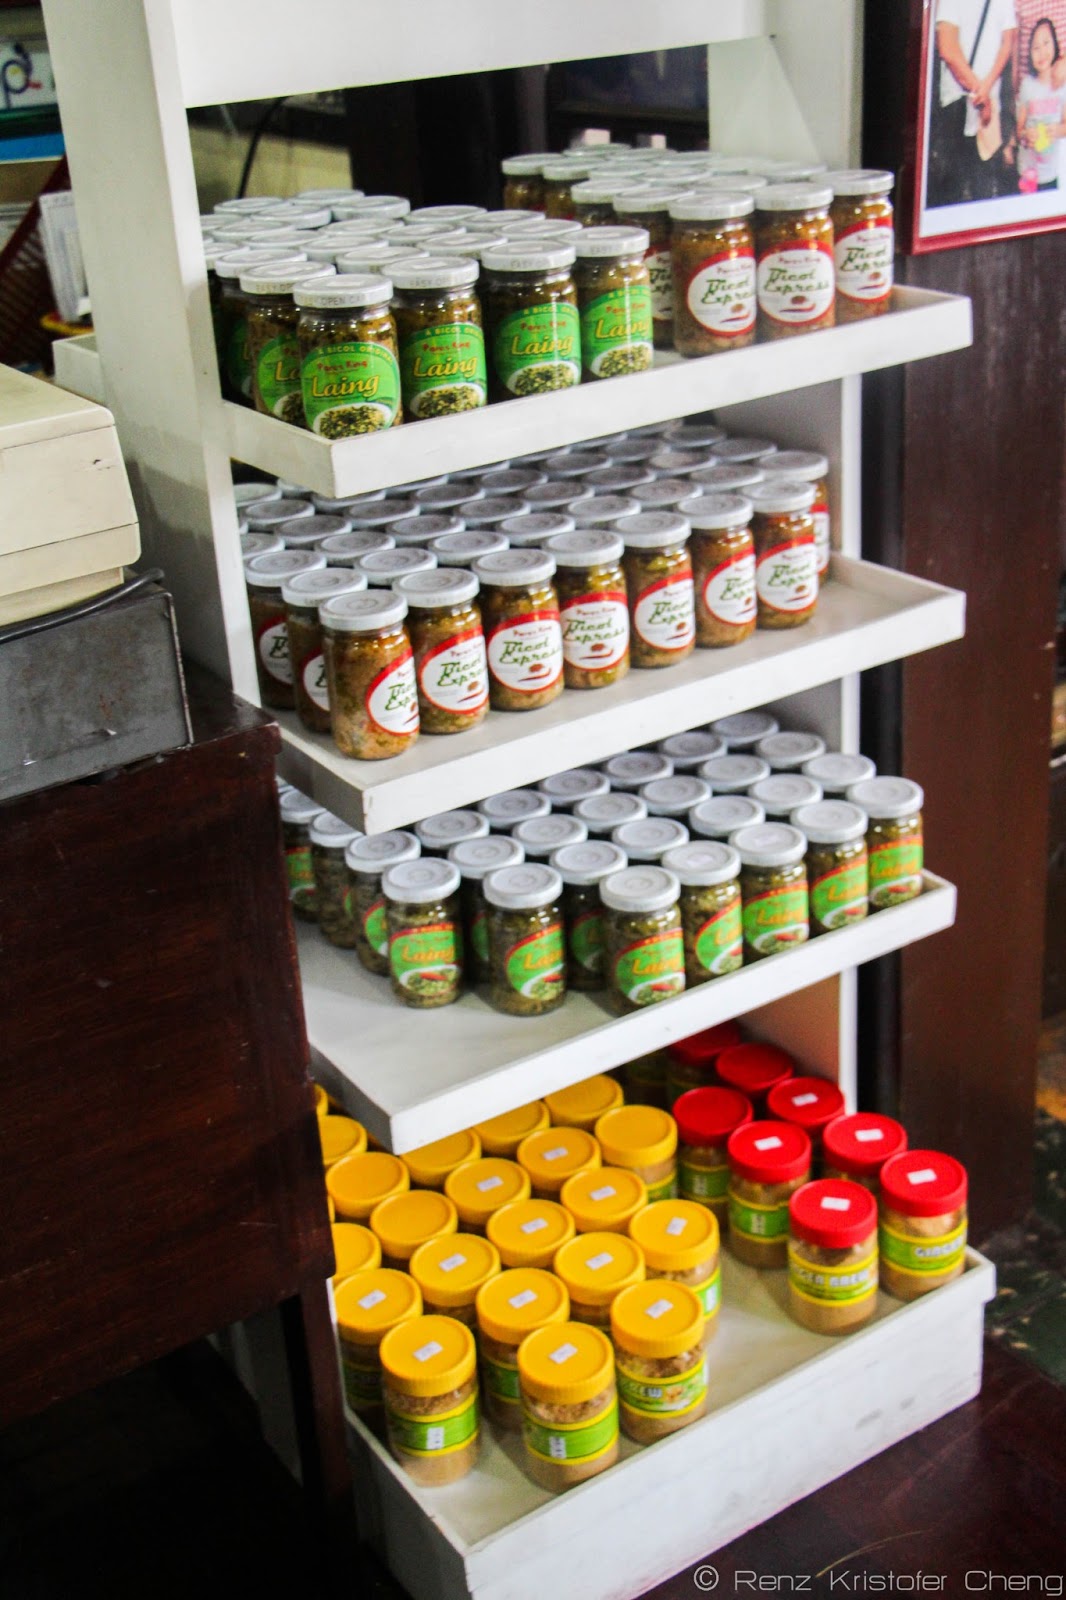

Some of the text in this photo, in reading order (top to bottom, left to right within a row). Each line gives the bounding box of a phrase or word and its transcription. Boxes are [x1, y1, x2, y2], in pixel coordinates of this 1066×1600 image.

[511, 335, 575, 356] Laing
[413, 356, 479, 378] Laing
[311, 374, 380, 398] Laing
